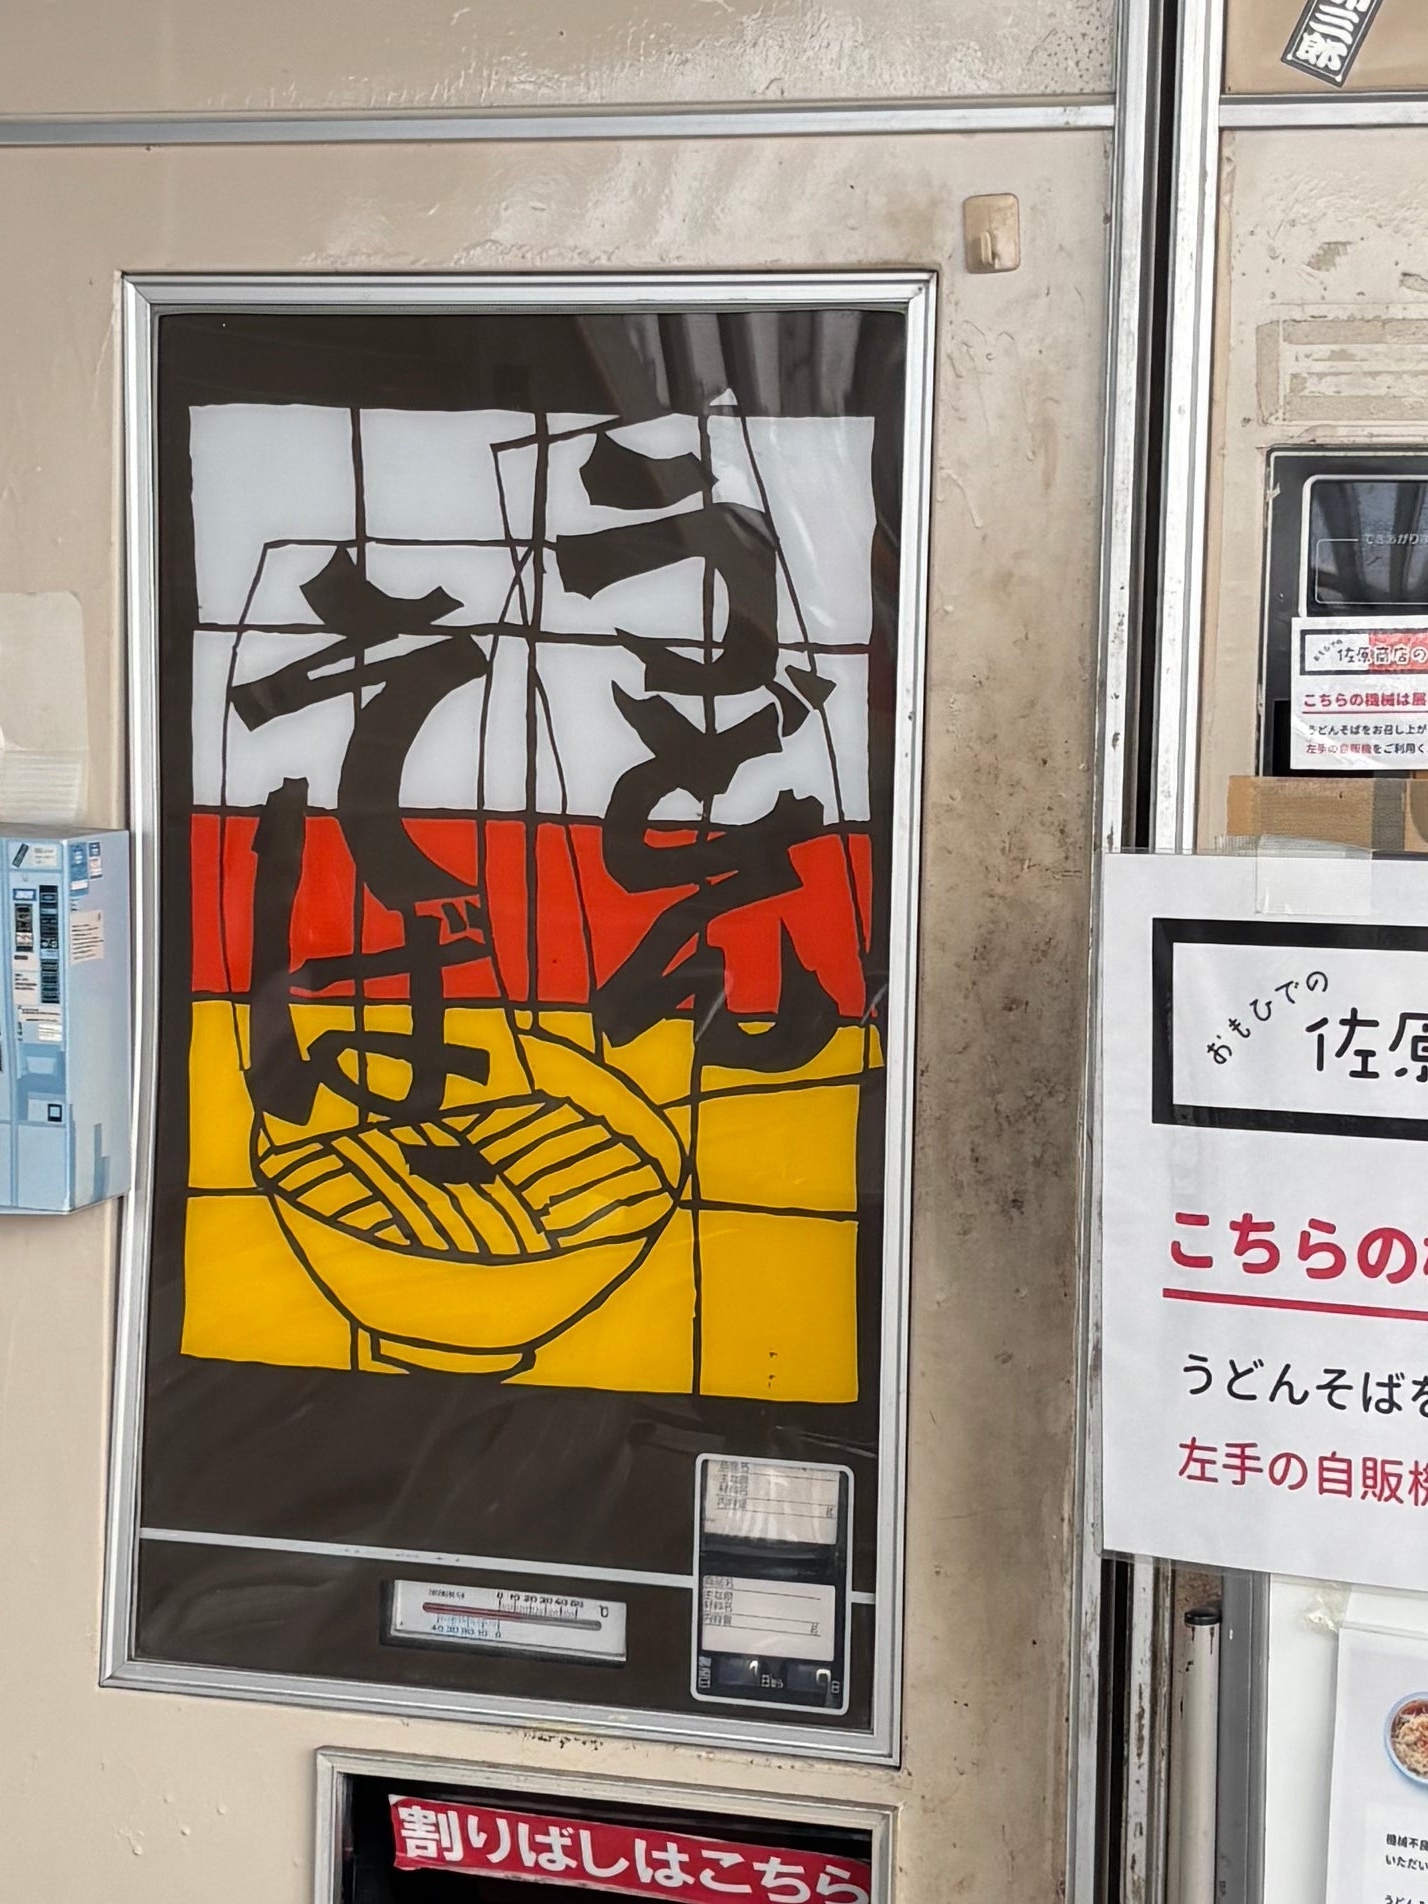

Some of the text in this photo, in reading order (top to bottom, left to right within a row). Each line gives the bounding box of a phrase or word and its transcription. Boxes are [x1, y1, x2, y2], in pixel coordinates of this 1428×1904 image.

[228, 425, 841, 1128] うどん そば
[1205, 967, 1330, 1068] おもひでの
